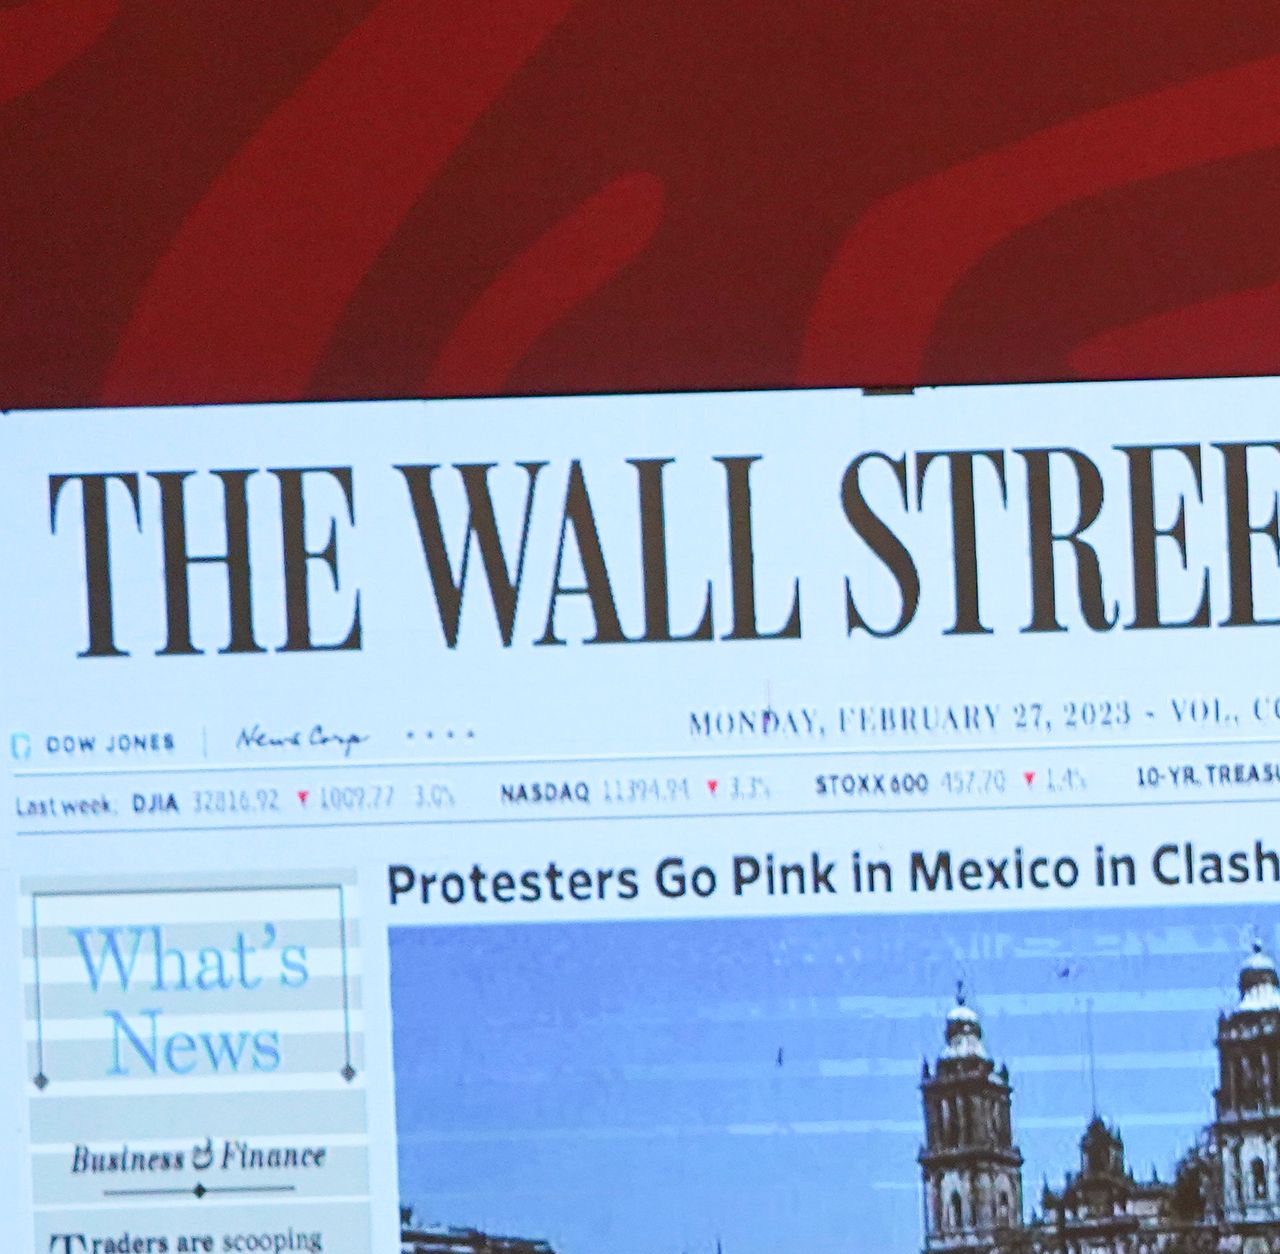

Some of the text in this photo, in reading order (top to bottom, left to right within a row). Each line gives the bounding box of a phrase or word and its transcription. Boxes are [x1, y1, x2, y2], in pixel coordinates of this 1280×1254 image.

[48, 465, 363, 659] THE
[392, 454, 802, 651] WALL
[690, 705, 826, 740] MONDAY,
[838, 702, 997, 735] FEBRUARY
[1014, 702, 1053, 733] 27,
[1063, 698, 1132, 728] 2023
[46, 732, 176, 756] DOW JONES
[501, 781, 590, 804] NASDAQ
[815, 773, 883, 798] STOXX
[888, 772, 930, 795] 600
[15, 796, 56, 817] Last
[132, 792, 180, 814] DJIA
[388, 862, 639, 906] Protesters
[655, 857, 717, 899] Go
[733, 851, 837, 896] Pink
[852, 850, 893, 893] in
[910, 847, 1079, 892] Mexico
[1095, 845, 1135, 887] in
[1152, 839, 1280, 886] Clash
[68, 922, 309, 993] What's
[103, 1008, 281, 1076] News
[72, 1144, 184, 1174] Business
[221, 1141, 326, 1169] Finance
[177, 1235, 214, 1254] are
[223, 1228, 323, 1254] scooping
